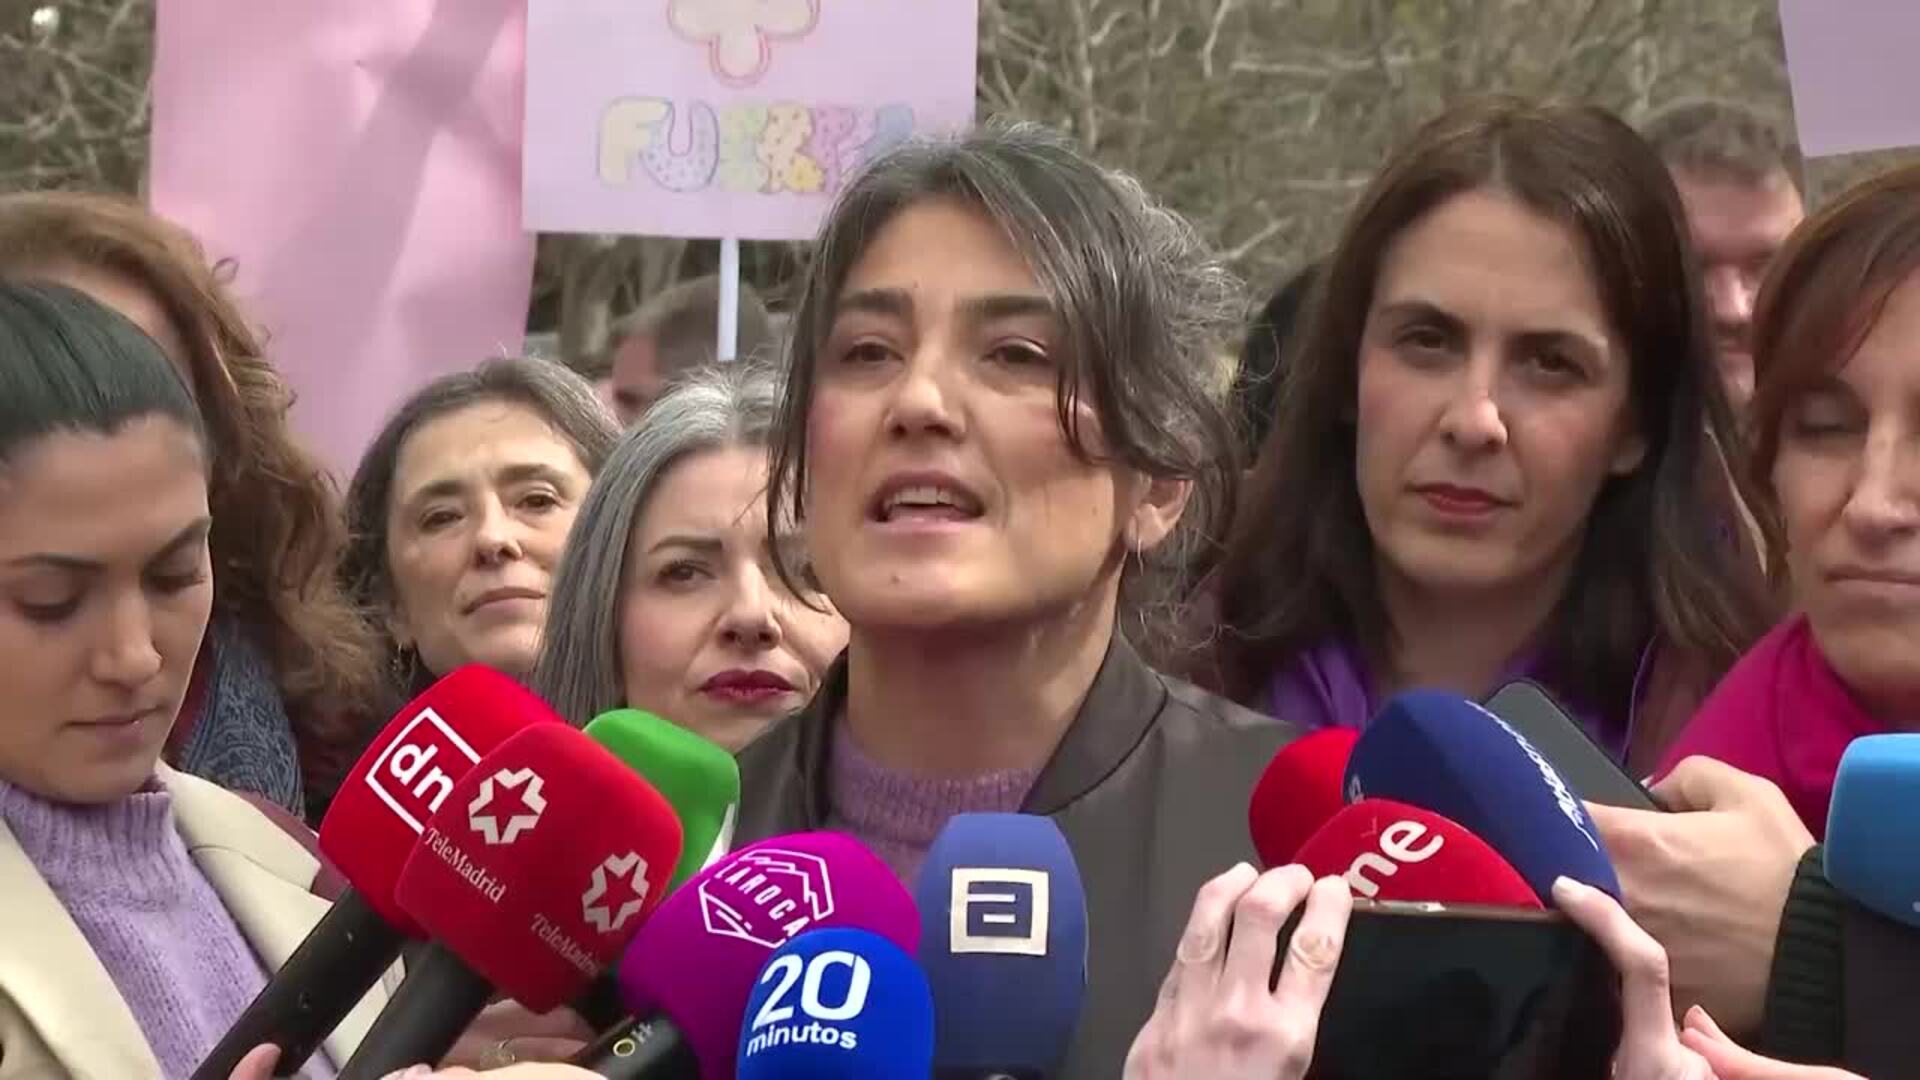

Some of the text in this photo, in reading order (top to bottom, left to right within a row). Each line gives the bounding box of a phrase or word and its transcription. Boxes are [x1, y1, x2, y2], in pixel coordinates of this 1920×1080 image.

[390, 743, 454, 813] dn
[425, 827, 507, 903] TeleMadrid
[752, 950, 871, 1032] 20
[746, 1021, 858, 1057] minutos
